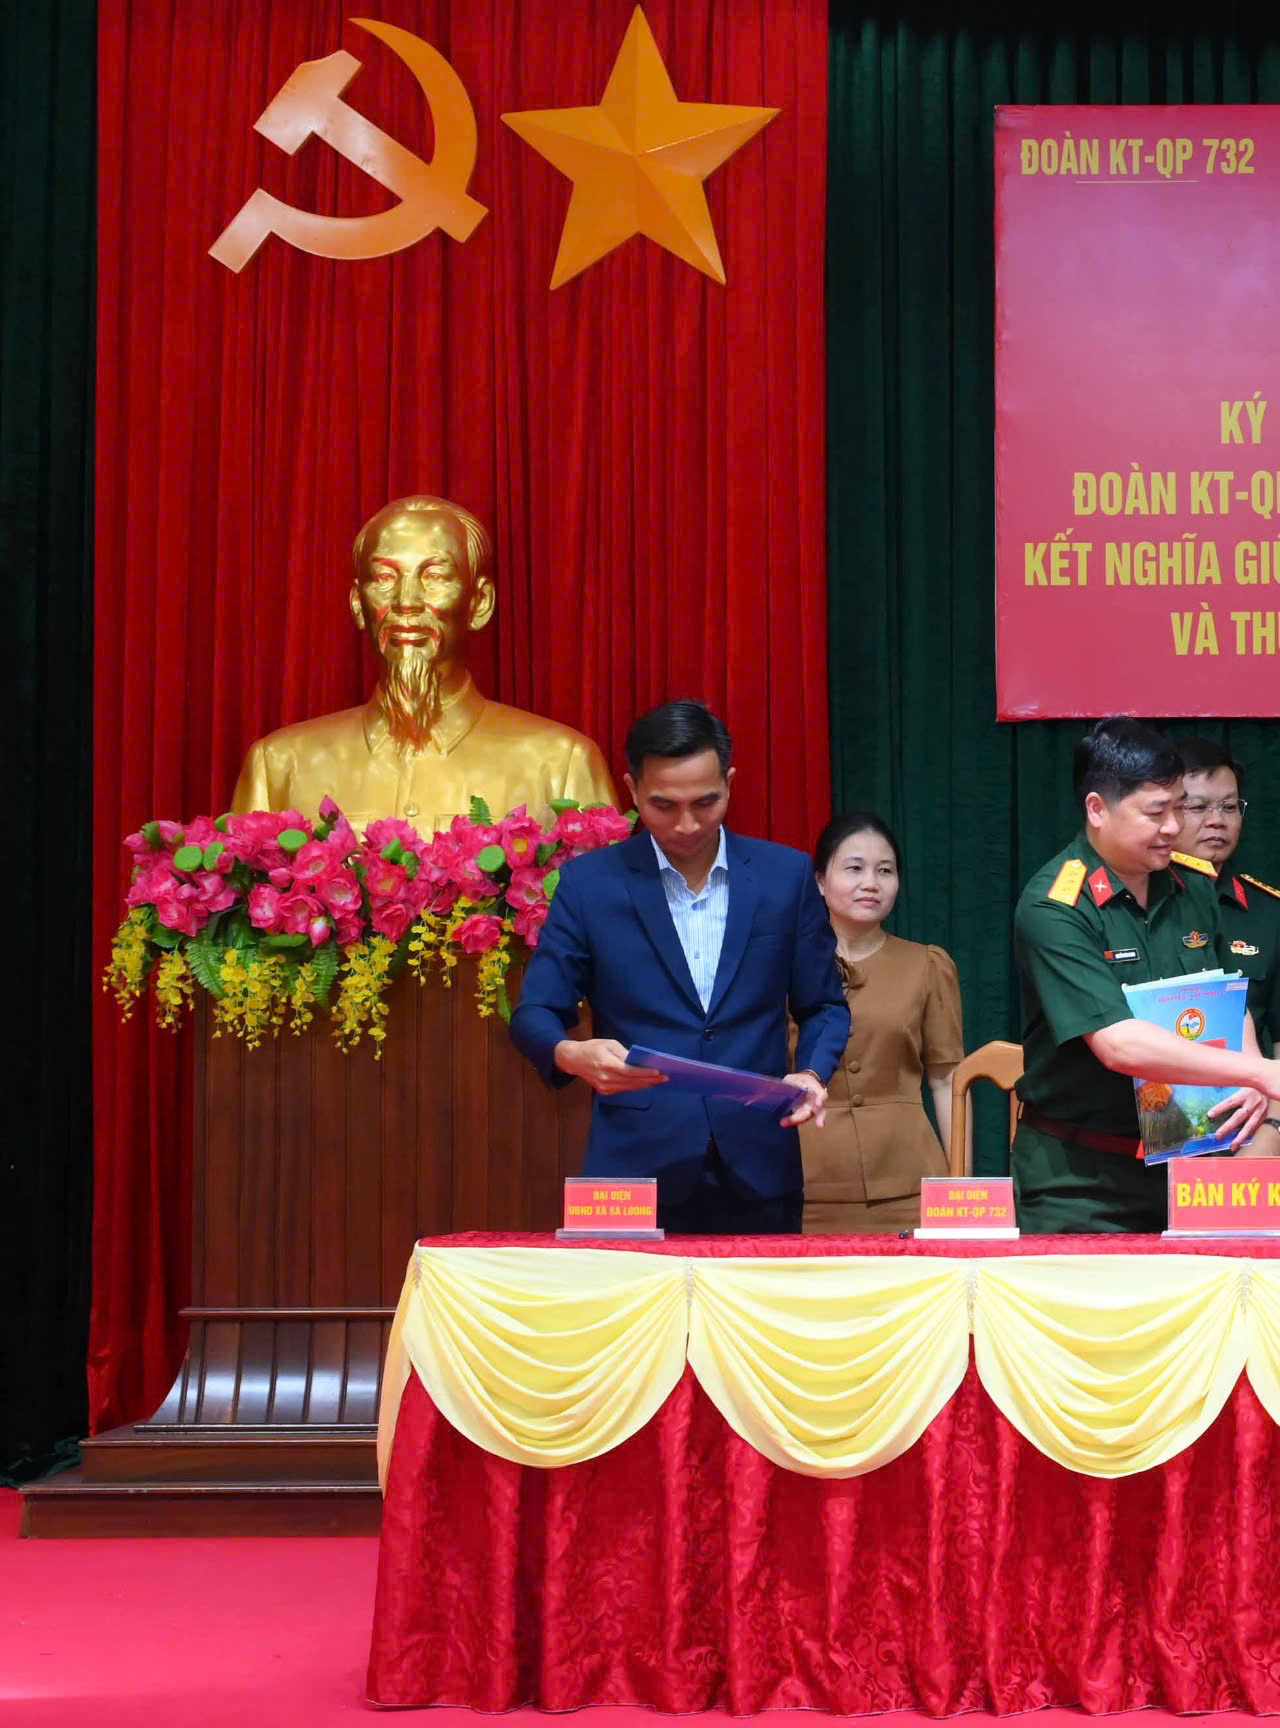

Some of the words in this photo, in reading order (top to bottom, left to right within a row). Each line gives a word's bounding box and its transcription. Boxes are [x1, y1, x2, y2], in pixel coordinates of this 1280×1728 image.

[1021, 138, 1100, 176] ĐOÀN
[1110, 138, 1194, 177] KT-QP
[1203, 138, 1255, 174] 732
[1220, 391, 1267, 444] KÝ
[1073, 463, 1177, 516] ĐOÀN
[1024, 527, 1093, 586] KẾT
[1105, 533, 1223, 586] NGHĨA
[1171, 601, 1220, 656] VÀ
[1176, 1177, 1225, 1208] BÀN
[1231, 1177, 1261, 1208] KÝ
